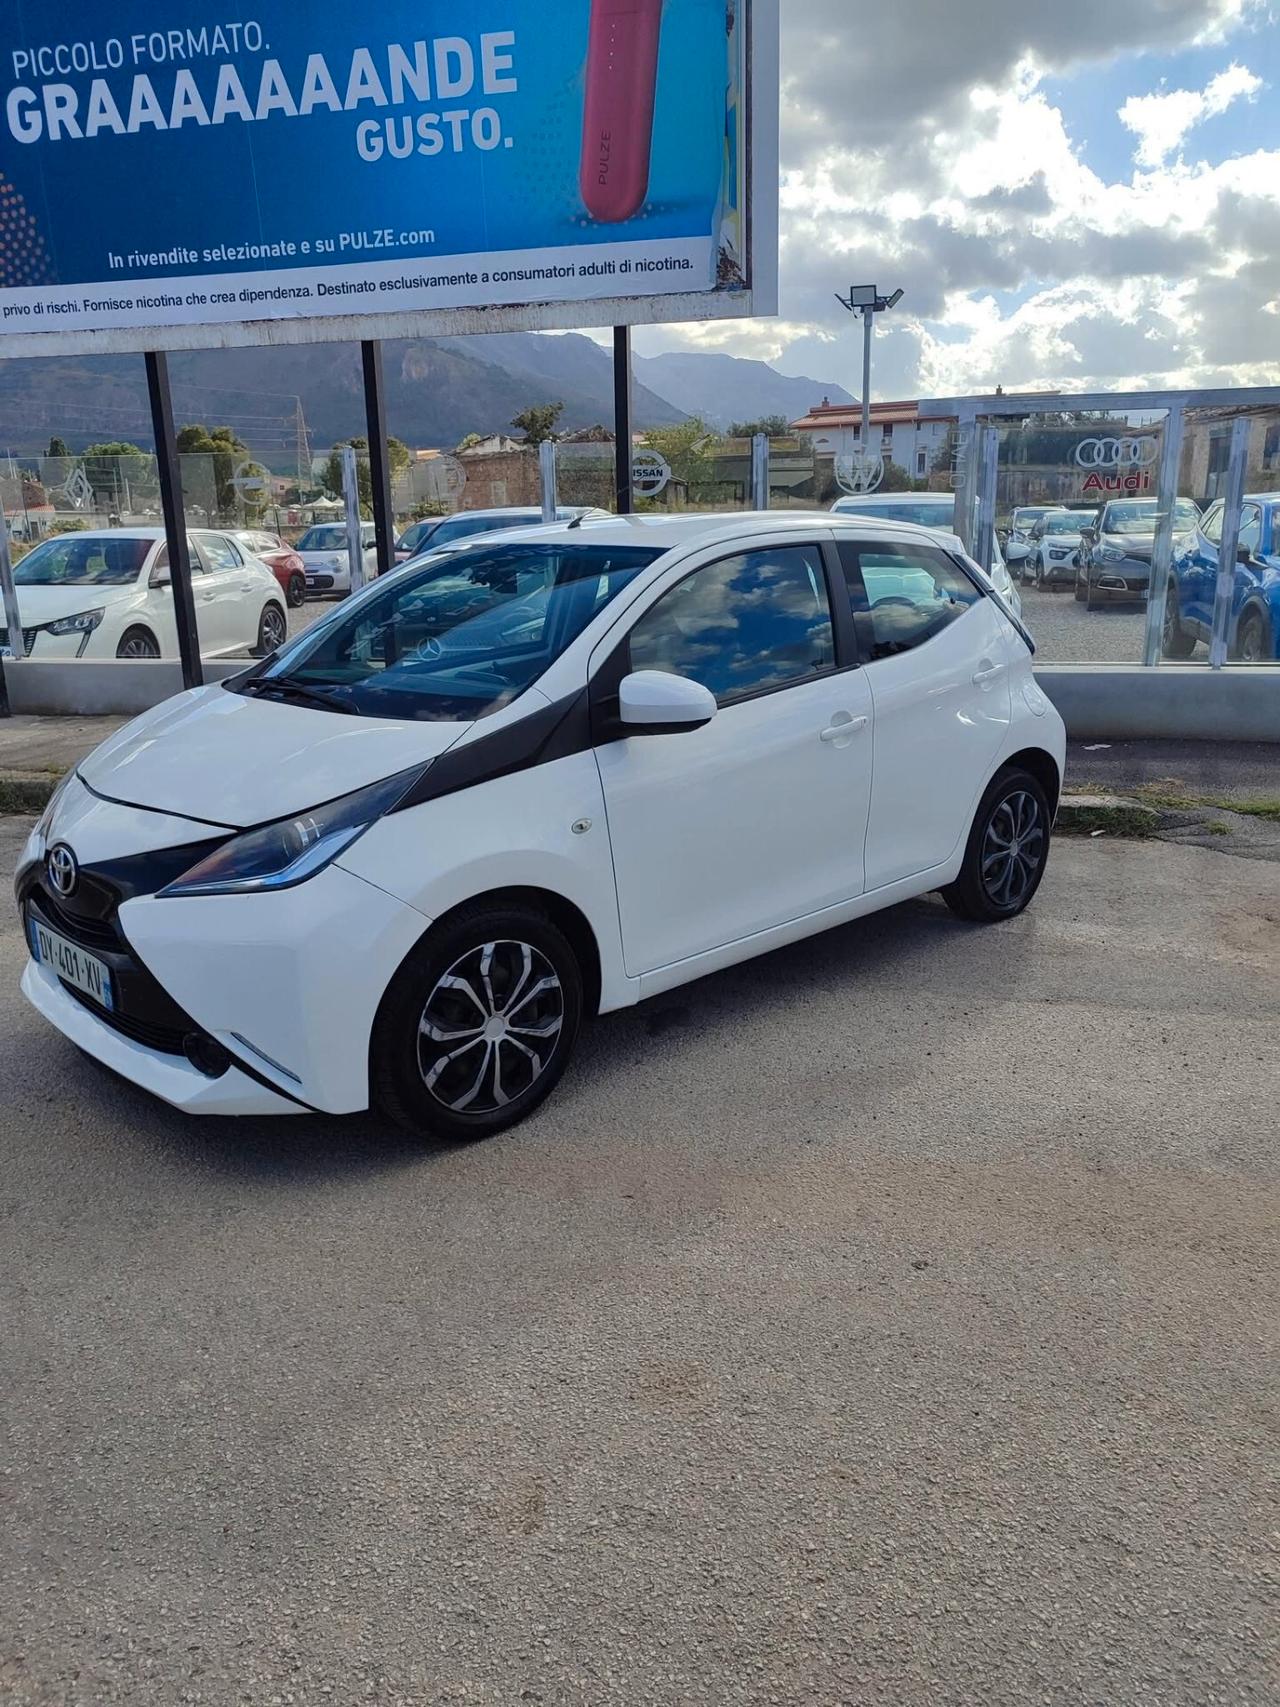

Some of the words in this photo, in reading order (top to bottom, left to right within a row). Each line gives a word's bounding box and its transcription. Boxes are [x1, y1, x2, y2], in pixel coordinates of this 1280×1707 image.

[12, 38, 124, 79] PICCOLO
[132, 21, 271, 65] FORMATO.
[6, 30, 518, 144] GRAAAAAAANDE
[356, 107, 514, 162] GUSTO.
[598, 129, 611, 185] PULZE
[109, 252, 124, 268] In
[128, 248, 199, 266] rivendite
[202, 240, 297, 262] selezionate
[301, 241, 311, 254] e
[315, 239, 335, 252] su
[339, 228, 435, 250] PULZE.com
[3, 304, 31, 317] privo
[33, 301, 44, 314] di
[47, 299, 82, 313] rischi.
[83, 297, 134, 312] Fornisce
[136, 294, 183, 308] nicotina
[185, 291, 207, 304] che
[210, 291, 236, 302] crea
[239, 285, 314, 303] dipendenza.
[317, 280, 376, 296] Destinato
[379, 272, 478, 291] esclusivamente
[481, 274, 490, 283] a
[492, 266, 575, 282] consumatori
[579, 262, 616, 276] adulti
[619, 260, 632, 273] di
[635, 258, 694, 272] nicotina.
[633, 469, 663, 477] ISSAN
[1082, 472, 1150, 491] Audi
